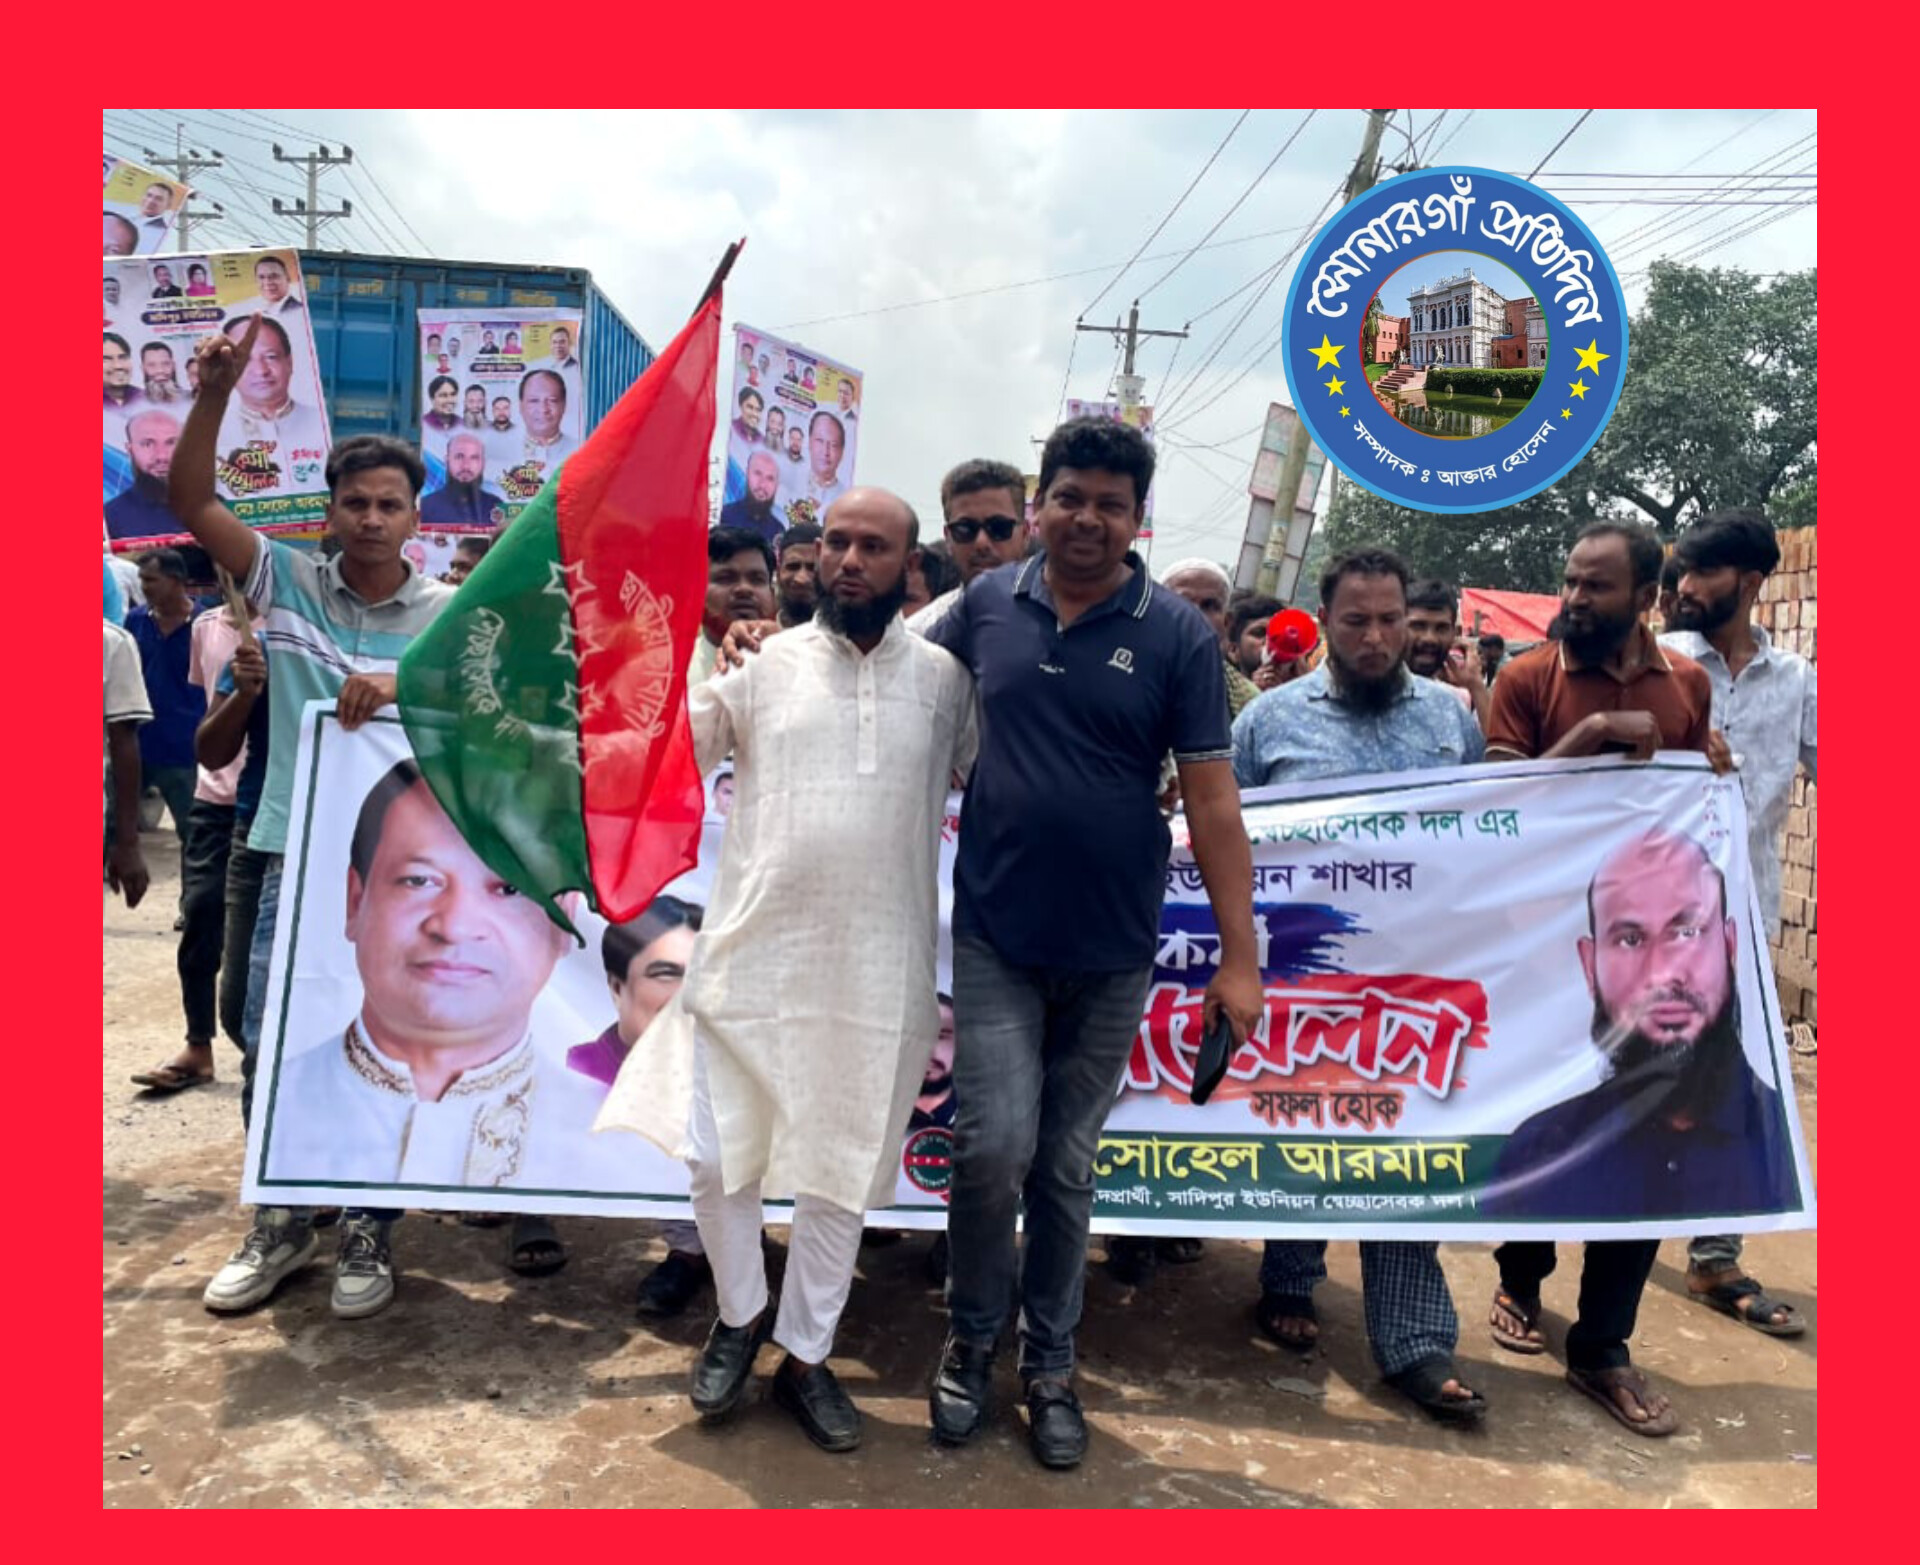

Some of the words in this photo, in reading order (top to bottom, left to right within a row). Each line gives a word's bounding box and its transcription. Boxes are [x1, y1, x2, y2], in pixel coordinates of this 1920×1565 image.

[1416, 809, 1464, 840] দল
[1474, 808, 1520, 837] এর
[1307, 859, 1417, 893] শাখার
[1252, 1089, 1323, 1124] সফল
[1329, 1089, 1400, 1123] হোক
[1092, 1137, 1265, 1181] সোহেল
[1276, 1138, 1471, 1183] আরমান
[1166, 1186, 1235, 1210] সাদিপুর
[1240, 1187, 1317, 1210] ইউনিয়ন
